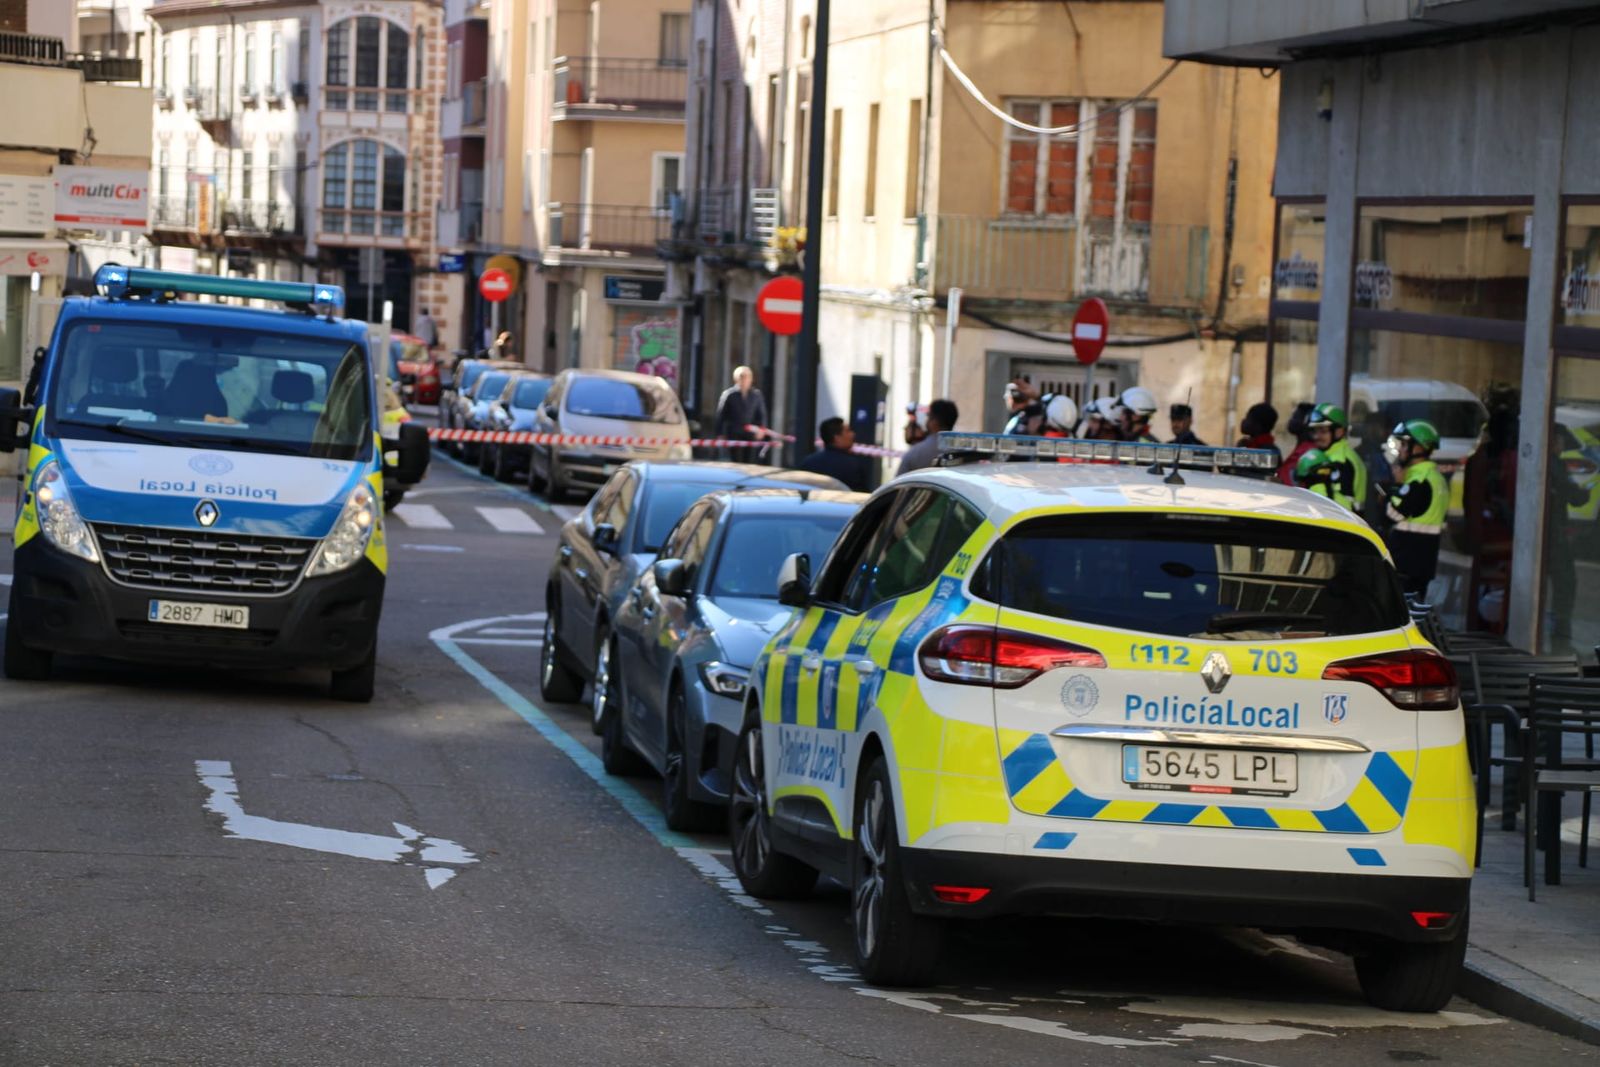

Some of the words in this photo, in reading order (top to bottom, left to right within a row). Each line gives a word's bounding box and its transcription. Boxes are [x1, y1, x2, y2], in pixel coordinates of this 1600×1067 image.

[70, 182, 141, 200] multiCia
[162, 604, 203, 622] 2887
[213, 607, 244, 625] HMD
[1139, 643, 1191, 667] 112
[1248, 649, 1298, 674] 703
[808, 732, 839, 783] Local
[1145, 749, 1220, 780] 5645
[1233, 753, 1288, 784] LPL
